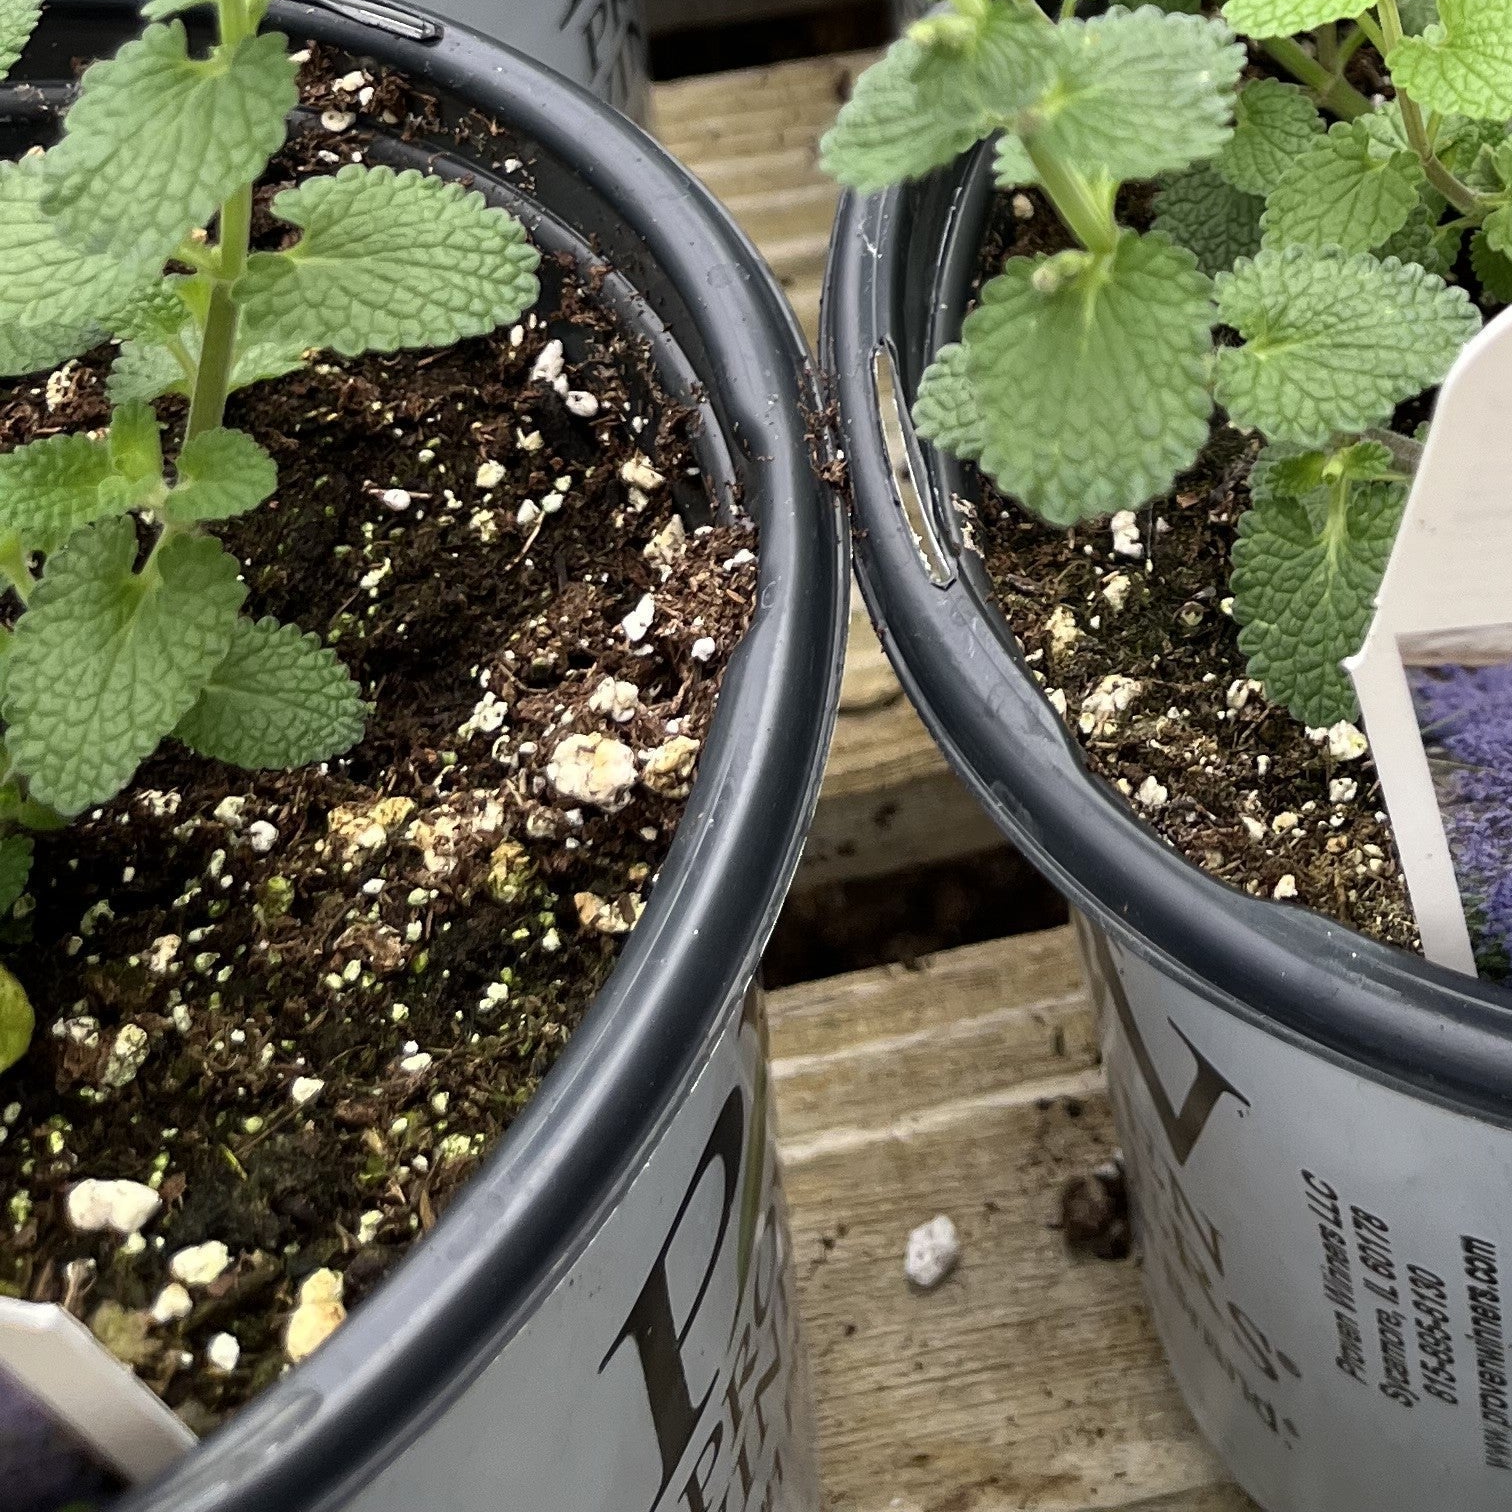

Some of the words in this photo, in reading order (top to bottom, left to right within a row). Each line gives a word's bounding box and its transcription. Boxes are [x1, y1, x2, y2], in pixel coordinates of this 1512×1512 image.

[1300, 1168, 1343, 1231] LLC
[1318, 1222, 1357, 1314] Winners
[1350, 1204, 1396, 1280] 60178
